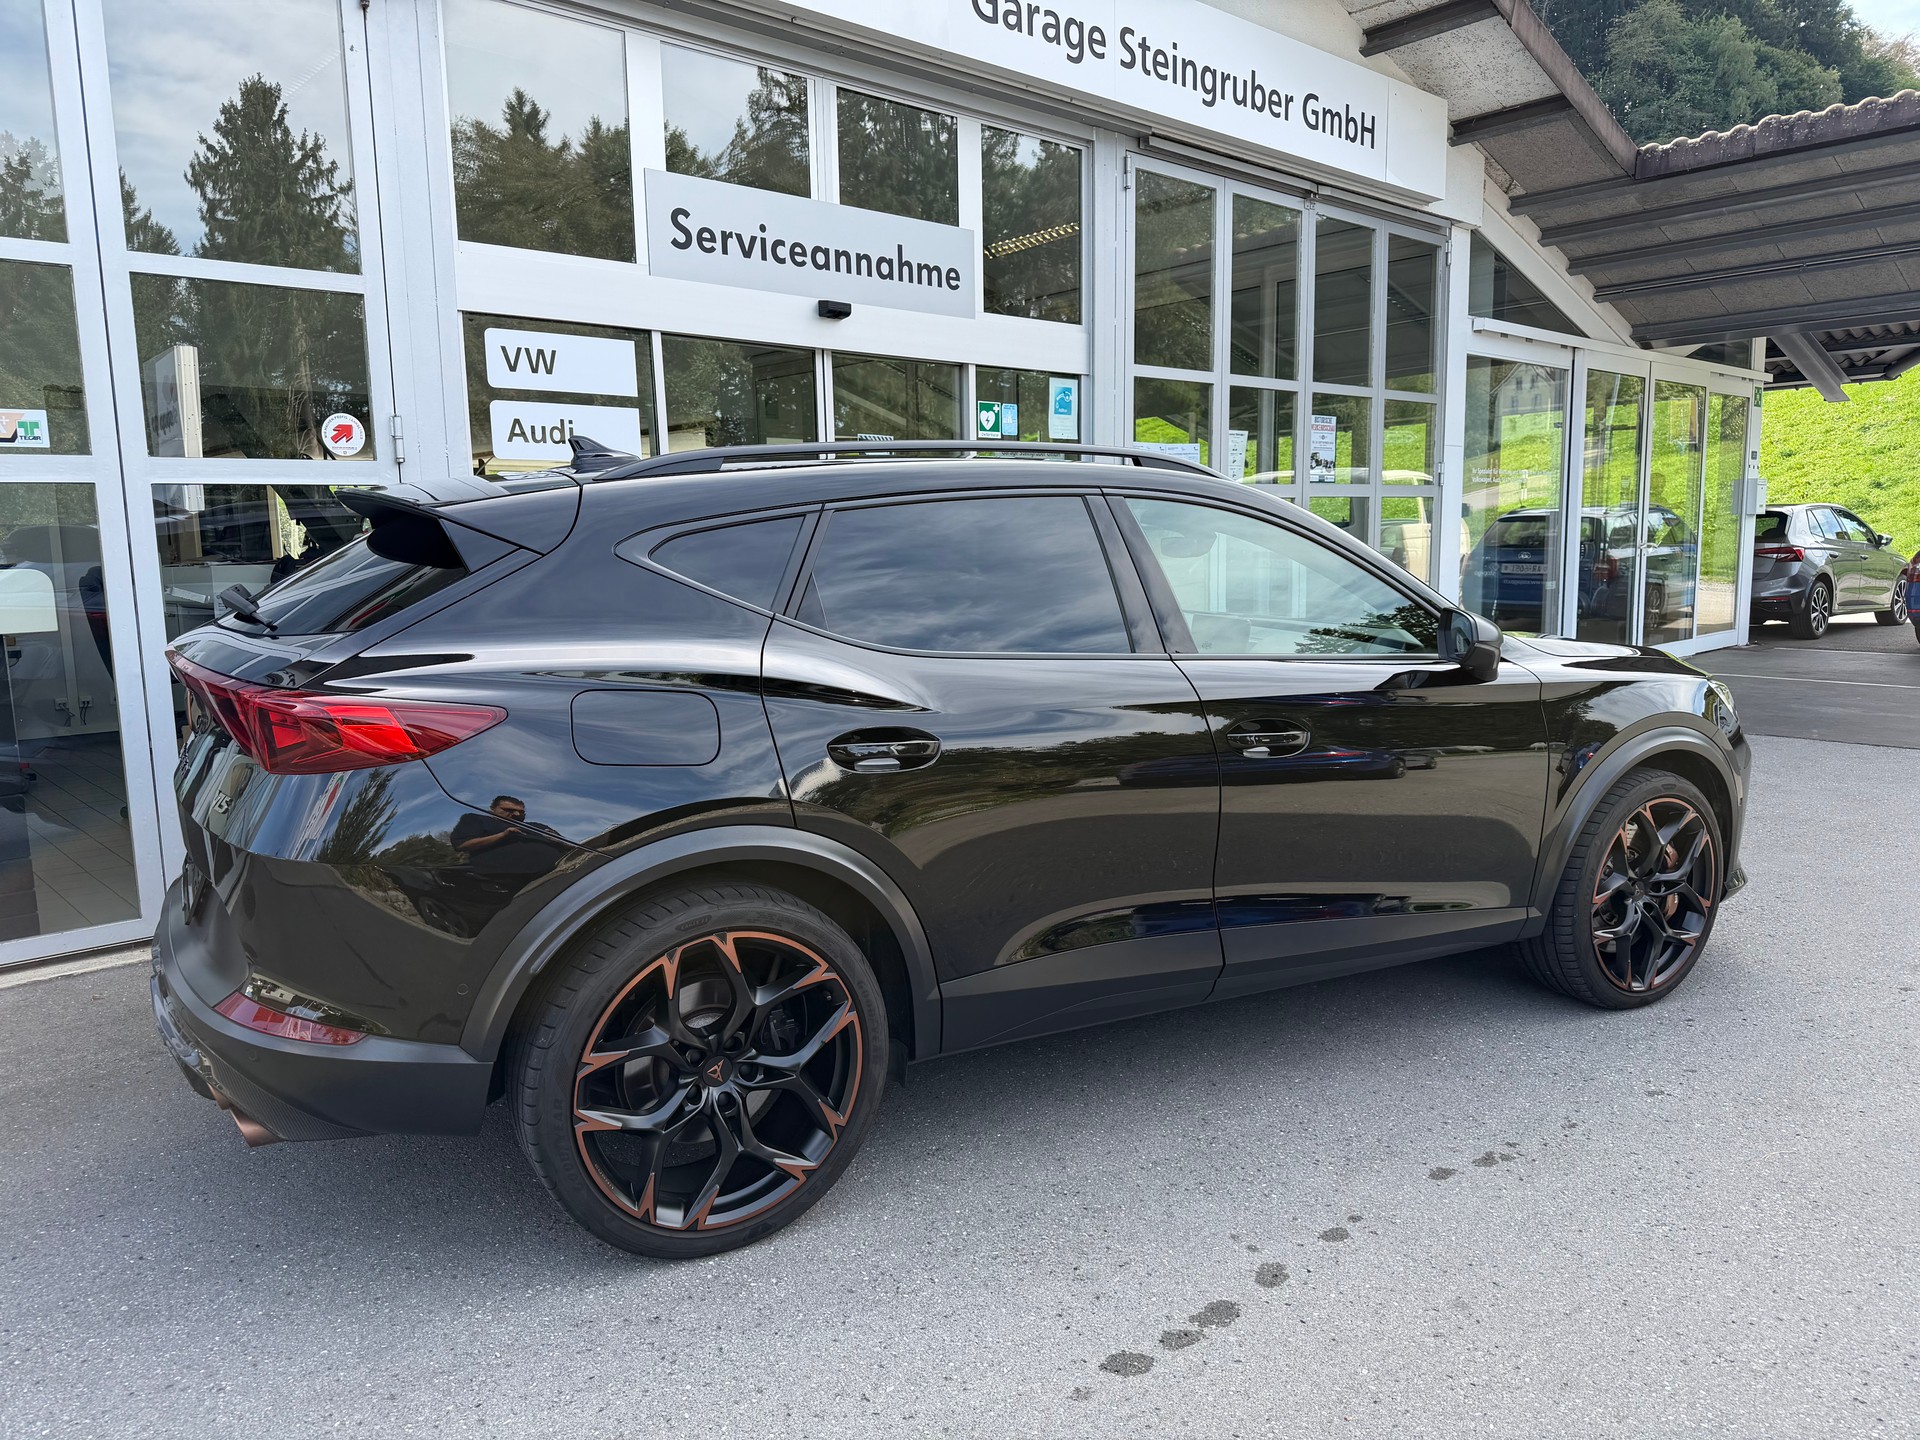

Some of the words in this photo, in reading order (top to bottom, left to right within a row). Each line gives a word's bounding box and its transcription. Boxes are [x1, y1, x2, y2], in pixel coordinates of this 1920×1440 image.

[972, 0, 1106, 64] Garage
[1119, 26, 1295, 122] Steingruber
[1302, 92, 1377, 149] GmbH
[669, 207, 961, 291] Serviceannahme
[499, 344, 557, 375] VW
[506, 418, 574, 445] Audi
